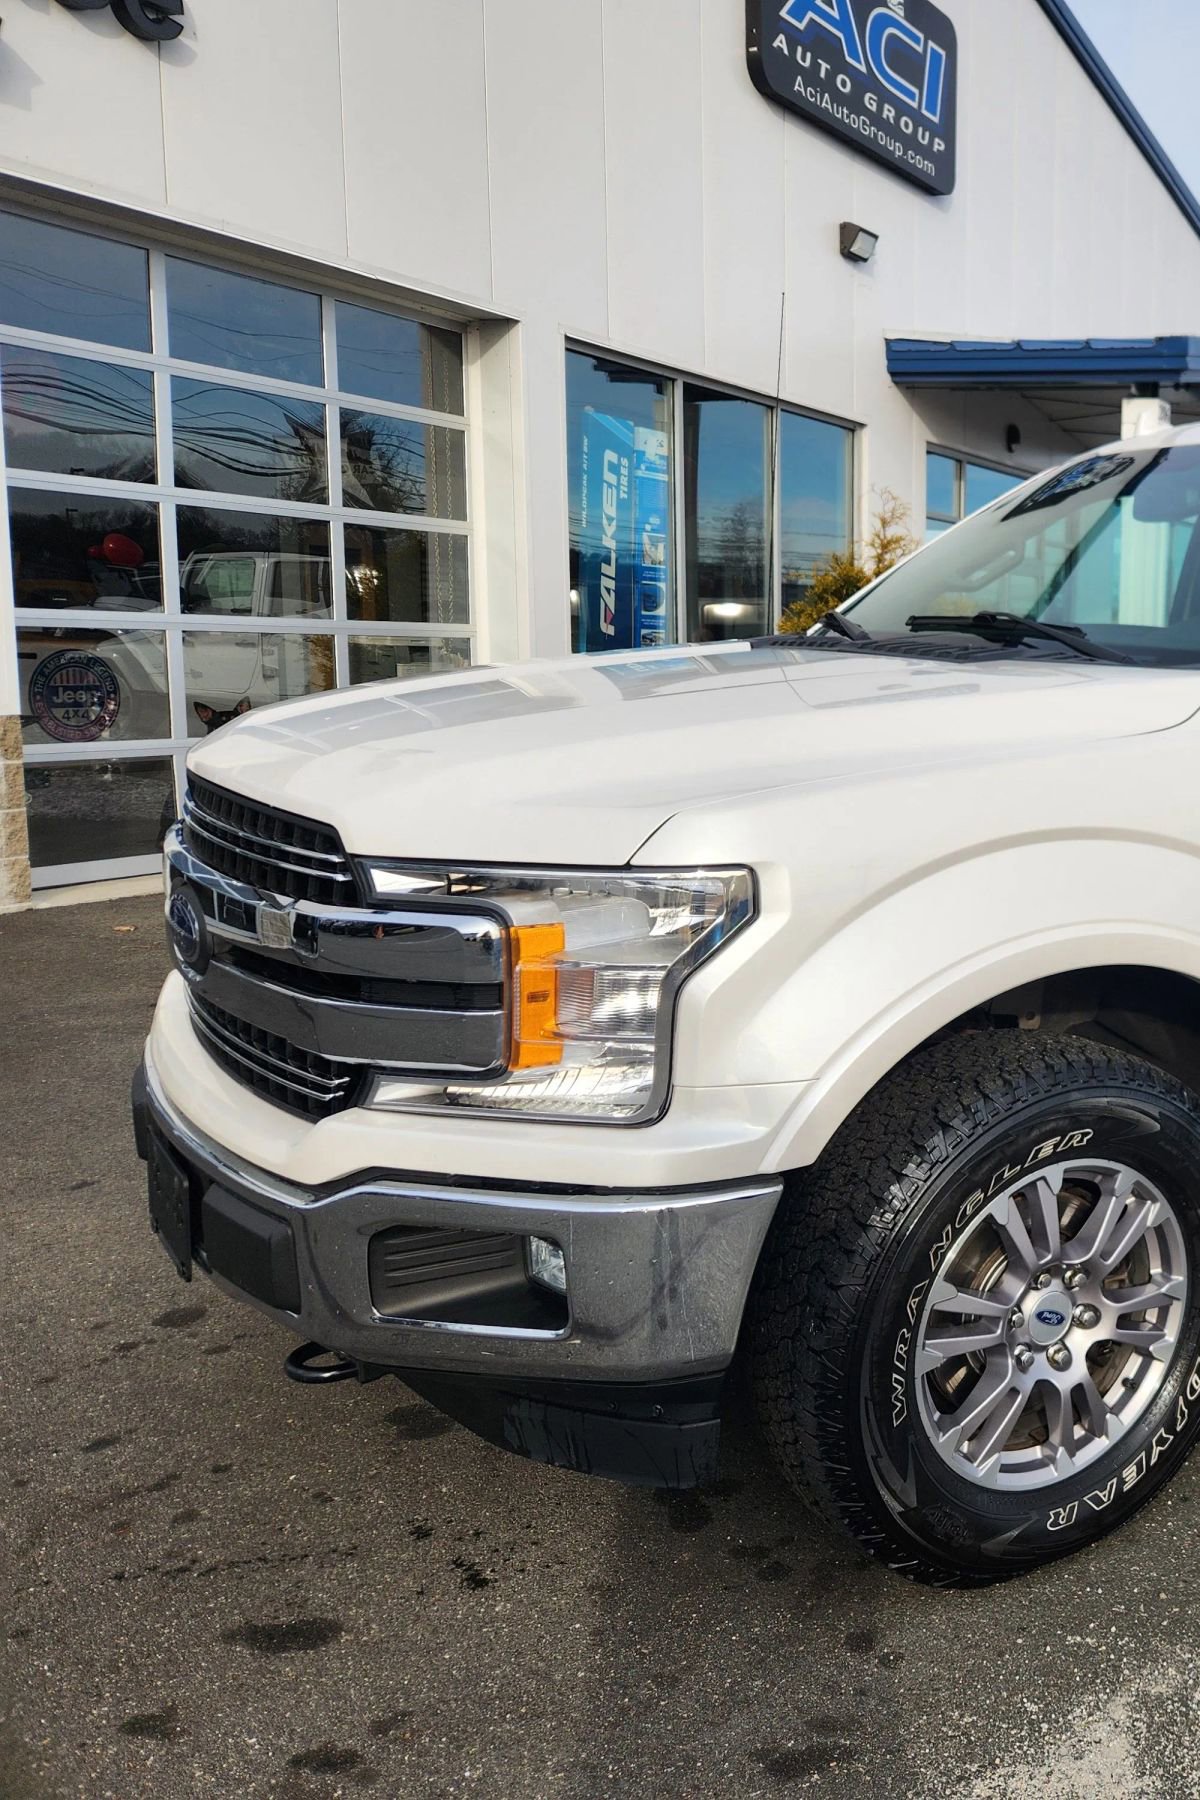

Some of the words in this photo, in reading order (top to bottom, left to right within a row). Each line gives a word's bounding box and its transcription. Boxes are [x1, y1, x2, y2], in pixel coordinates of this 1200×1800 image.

[772, 33, 851, 93] AUTO
[864, 92, 946, 153] GROUP
[779, 0, 945, 123] ACI
[794, 75, 935, 176] AciAutoGroup.com
[619, 457, 629, 499] TIRES
[600, 449, 618, 636] FALKEN
[34, 674, 46, 692] THE
[89, 658, 115, 691] LEGEND
[52, 687, 98, 707] Jeep
[893, 1129, 1093, 1427] WRANGLER
[1039, 1311, 1063, 1324] Ford
